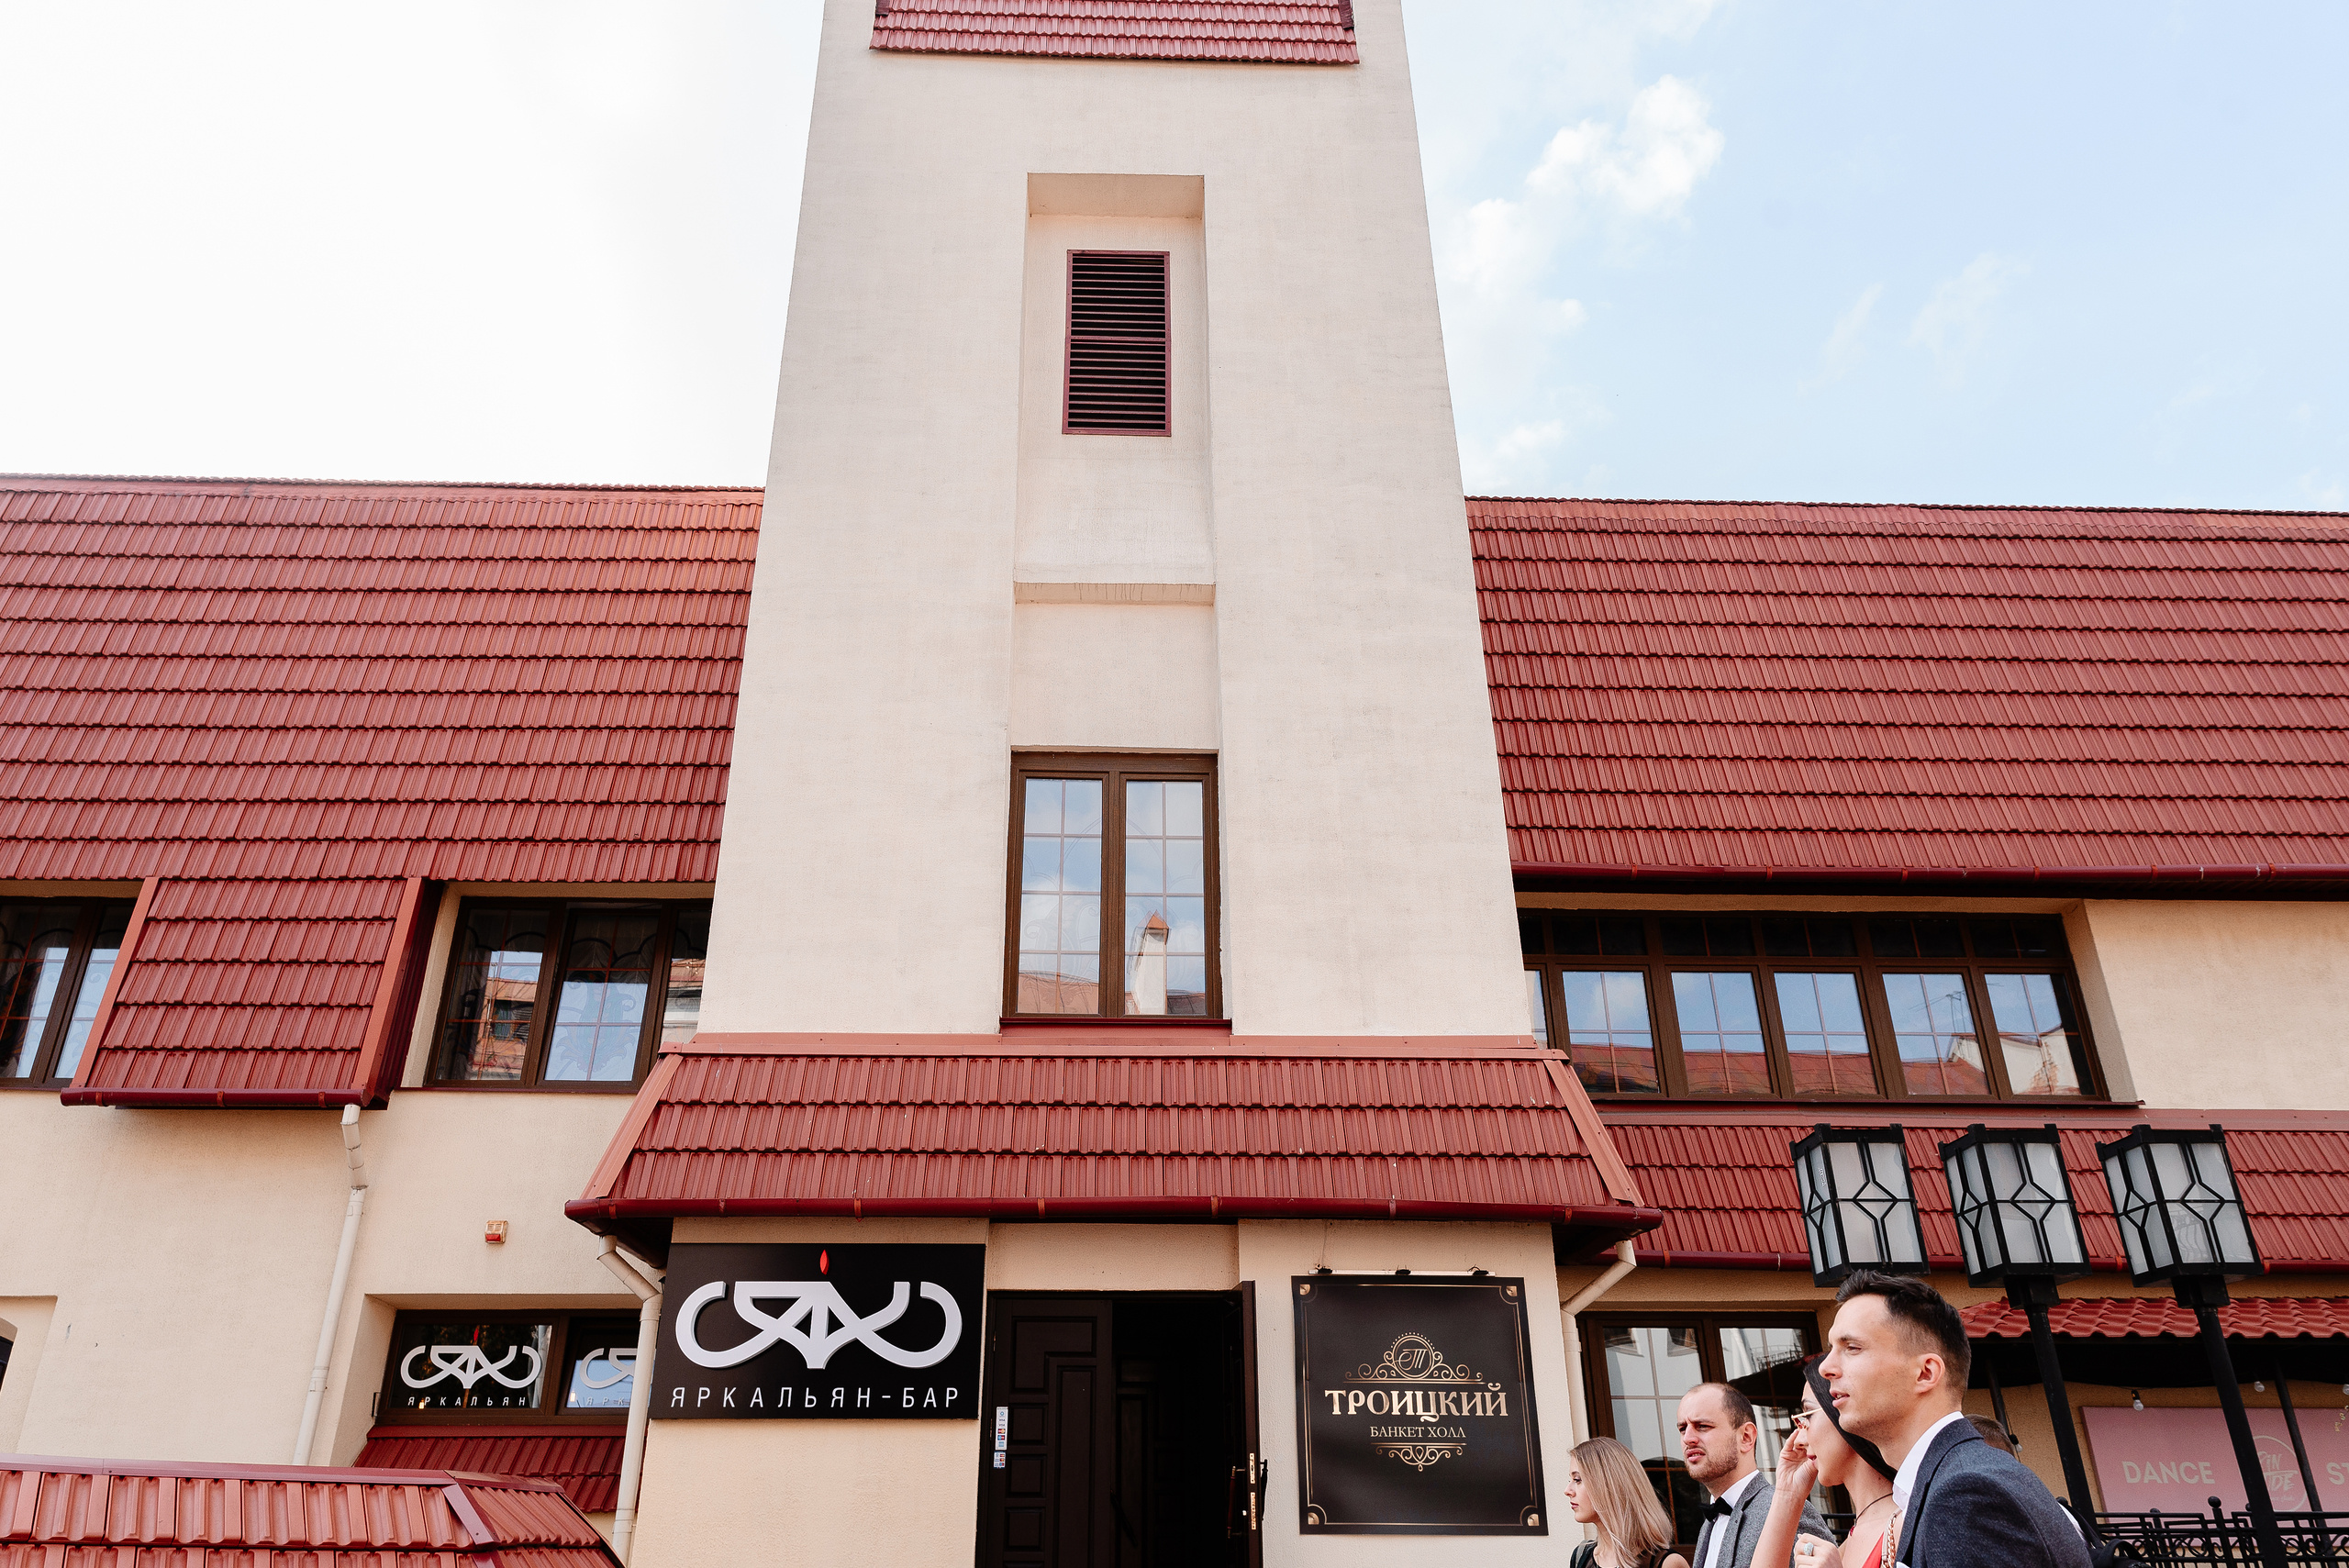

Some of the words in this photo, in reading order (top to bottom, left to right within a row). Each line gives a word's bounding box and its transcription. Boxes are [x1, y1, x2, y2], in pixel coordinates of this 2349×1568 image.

[407, 1396, 526, 1407] ЯРКАЛЬЯН
[670, 1386, 959, 1408] ЯРКАЛЬЯН-БАР
[1324, 1382, 1508, 1422] ТРОИЦКИЙ
[1370, 1426, 1424, 1438] БАНКЕТ
[1427, 1427, 1466, 1439] ХОЛЛ
[2121, 1461, 2216, 1485] DANCE
